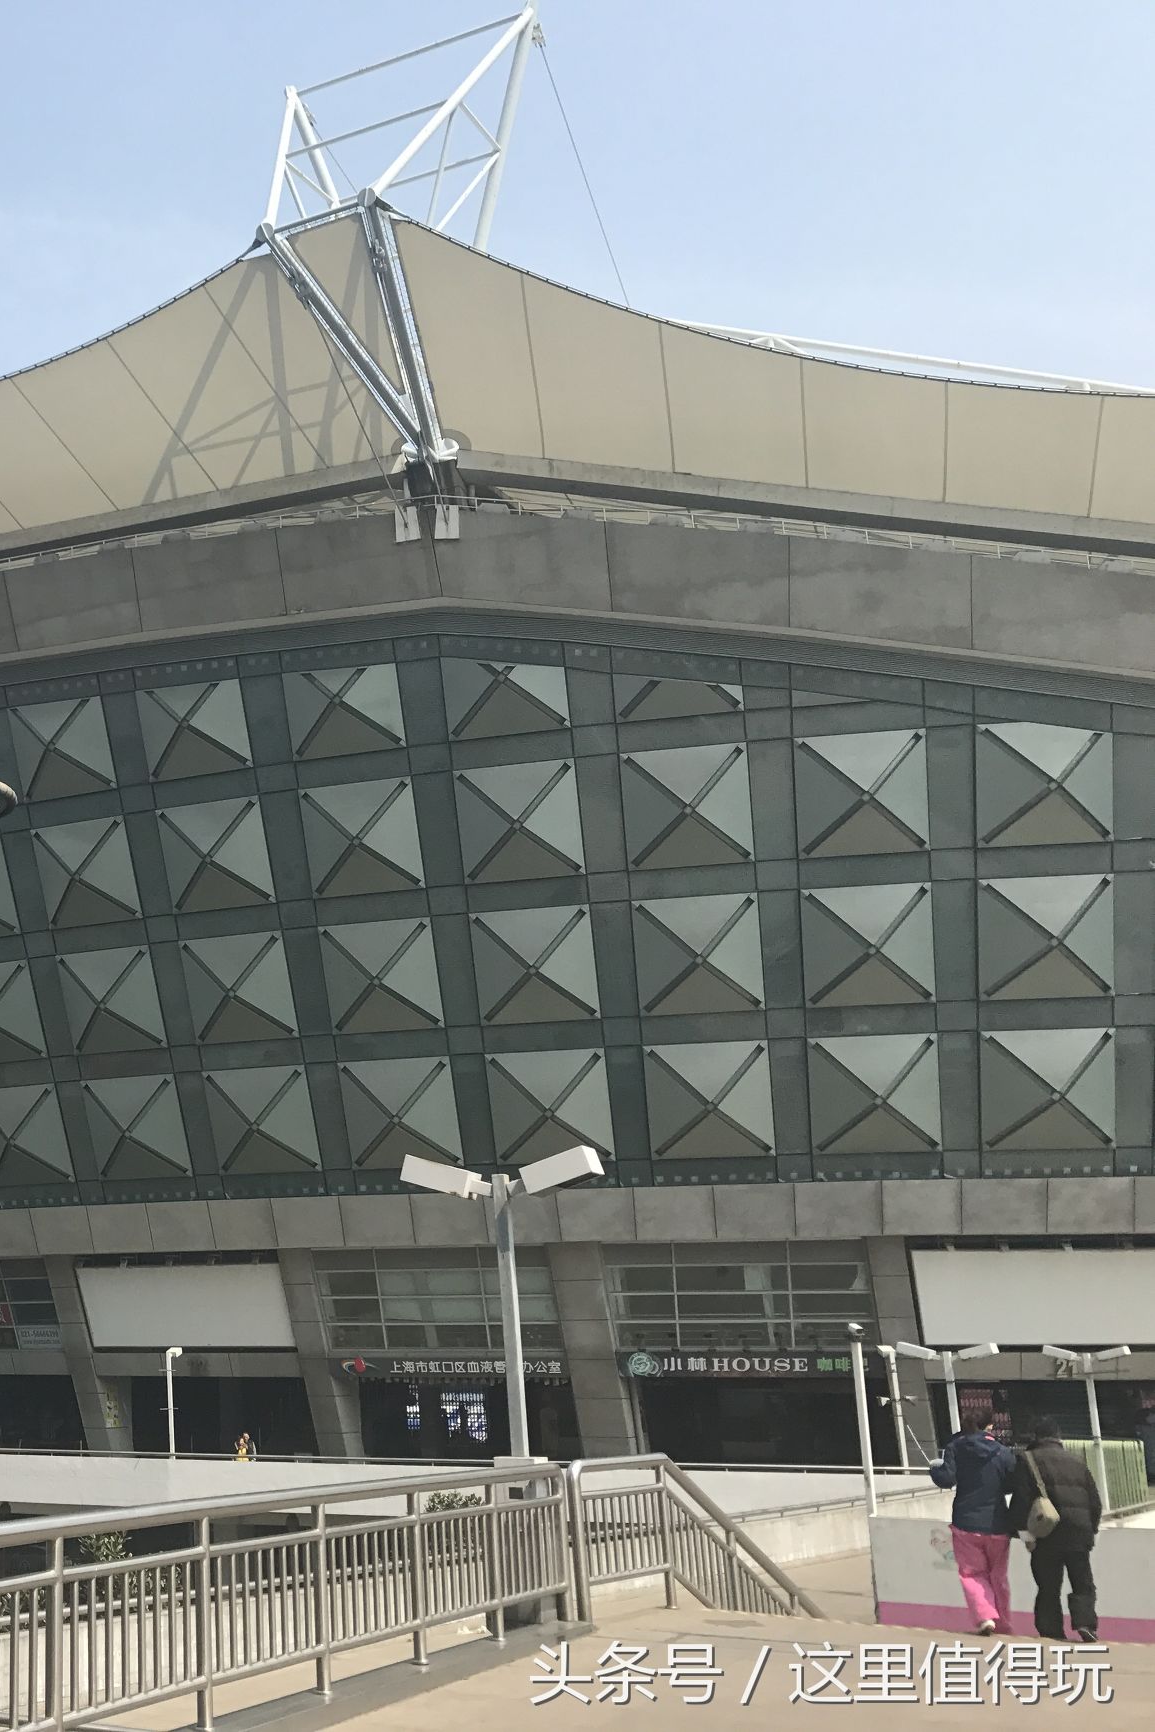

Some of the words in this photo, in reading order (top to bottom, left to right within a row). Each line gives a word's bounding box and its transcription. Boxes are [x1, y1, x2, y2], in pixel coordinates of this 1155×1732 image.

[389, 1360, 562, 1374] 上海市虹口区血液管办公室
[712, 1357, 808, 1373] HOUSE
[1056, 1359, 1078, 1379] 21
